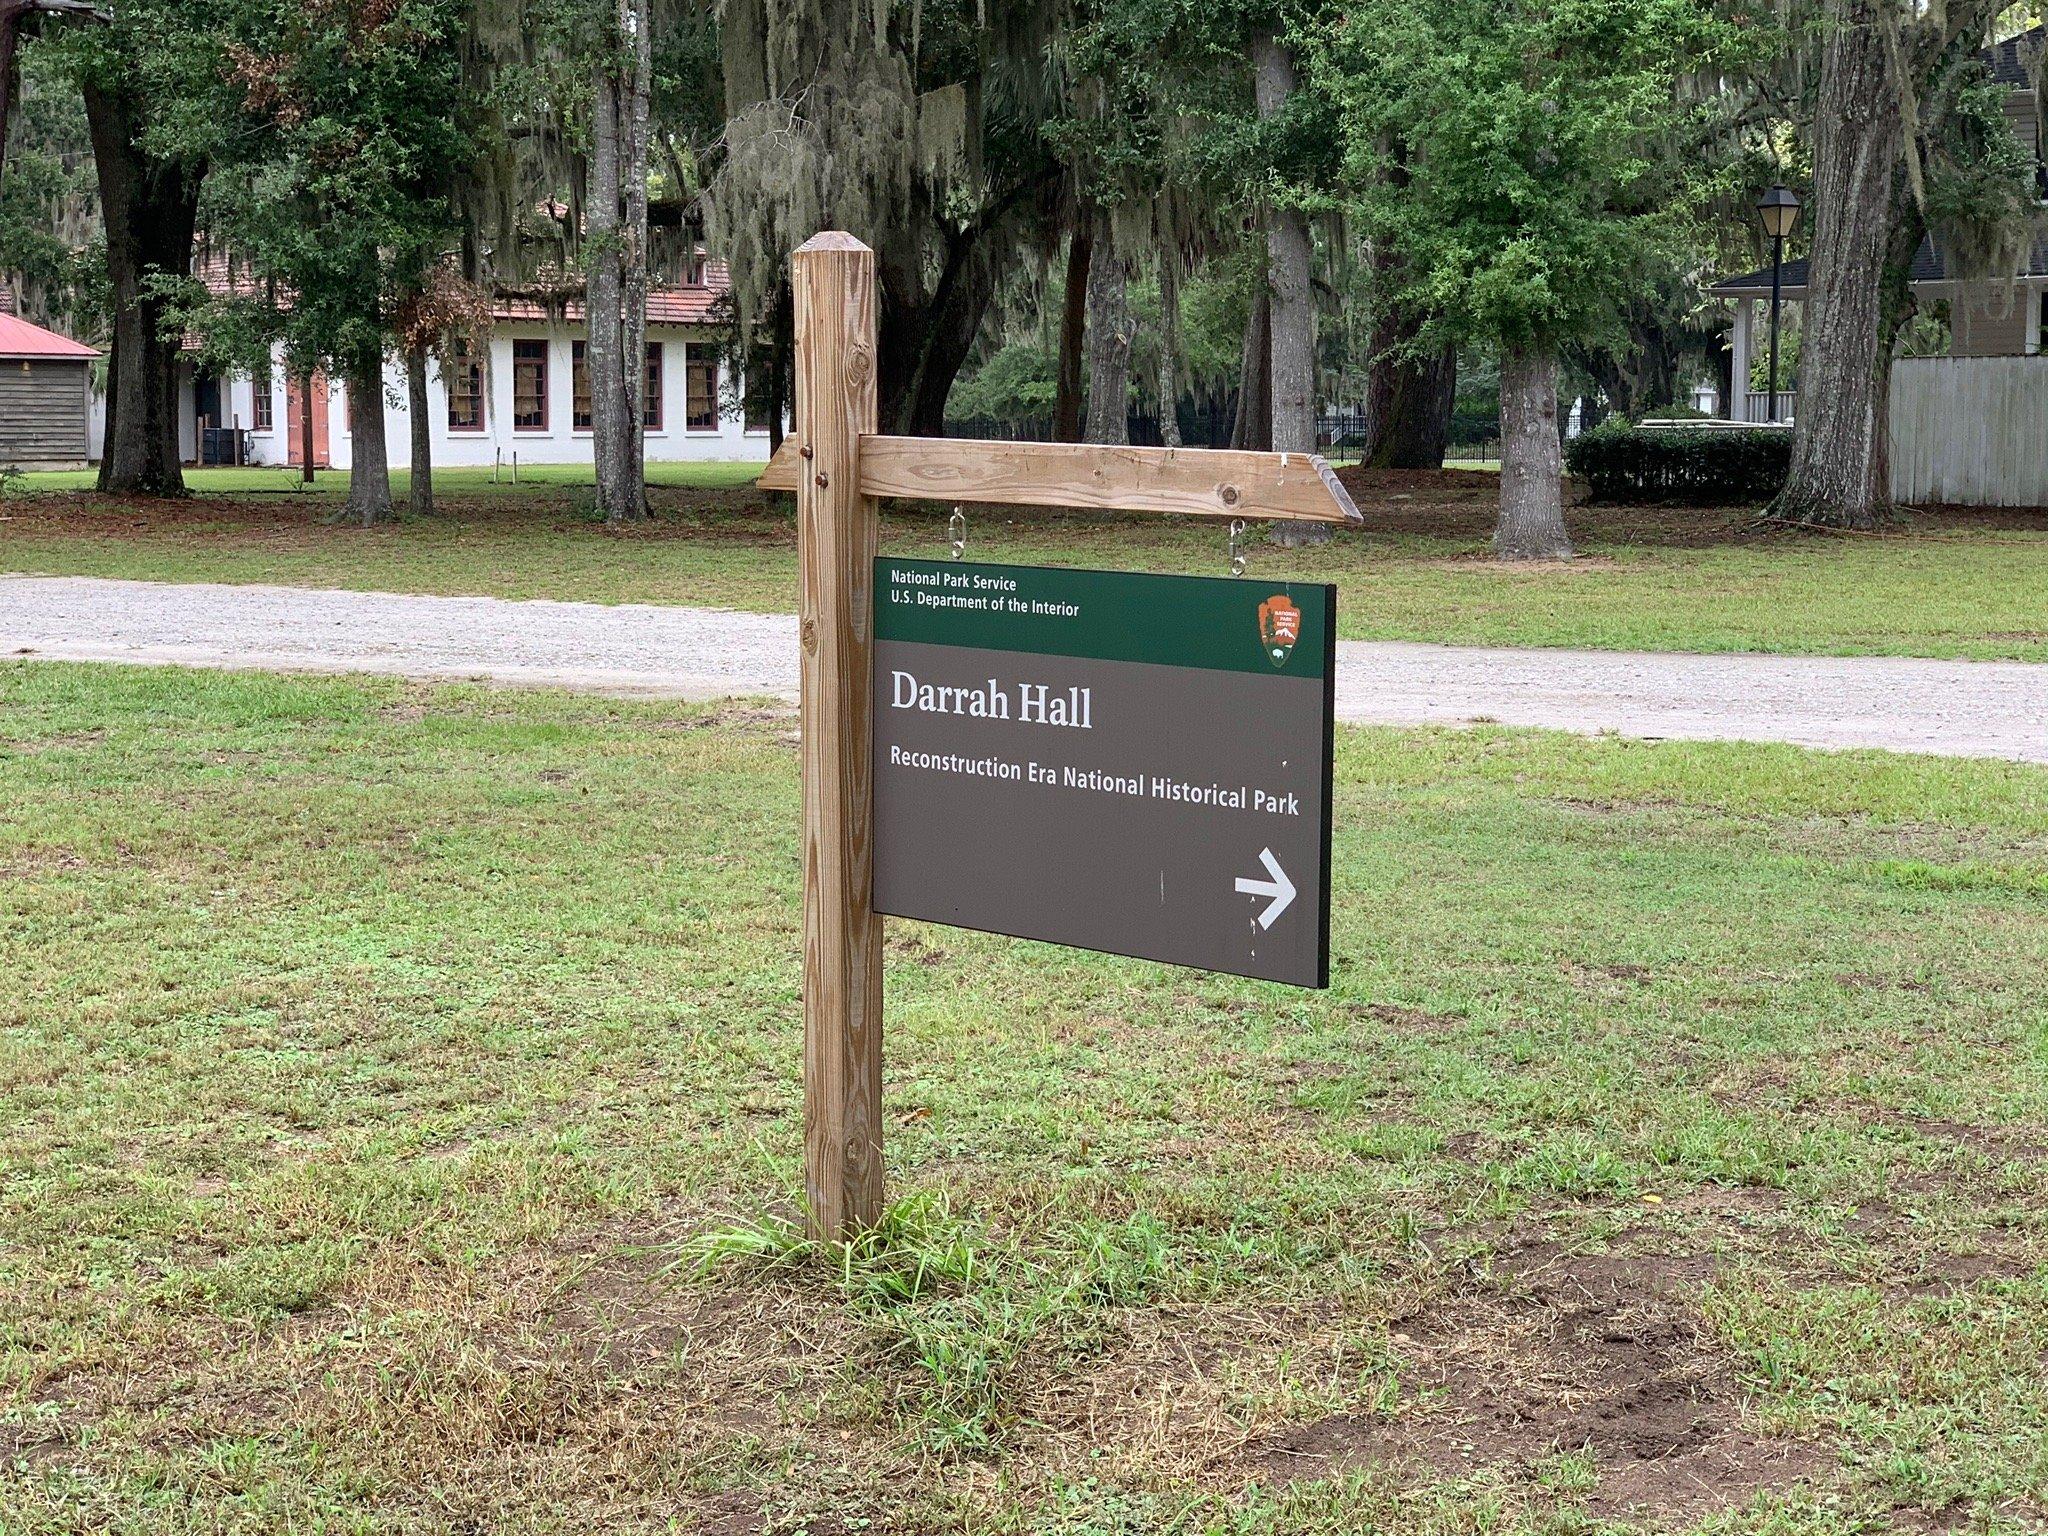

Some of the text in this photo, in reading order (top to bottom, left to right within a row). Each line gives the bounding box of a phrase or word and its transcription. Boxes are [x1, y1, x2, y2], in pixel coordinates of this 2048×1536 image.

[891, 570, 1017, 592] National Park Service
[891, 589, 1080, 617] U.S. Department of the Interior
[891, 670, 1093, 729] Darrah Hall
[890, 745, 1300, 816] Reconstruction Era National Historical Park
